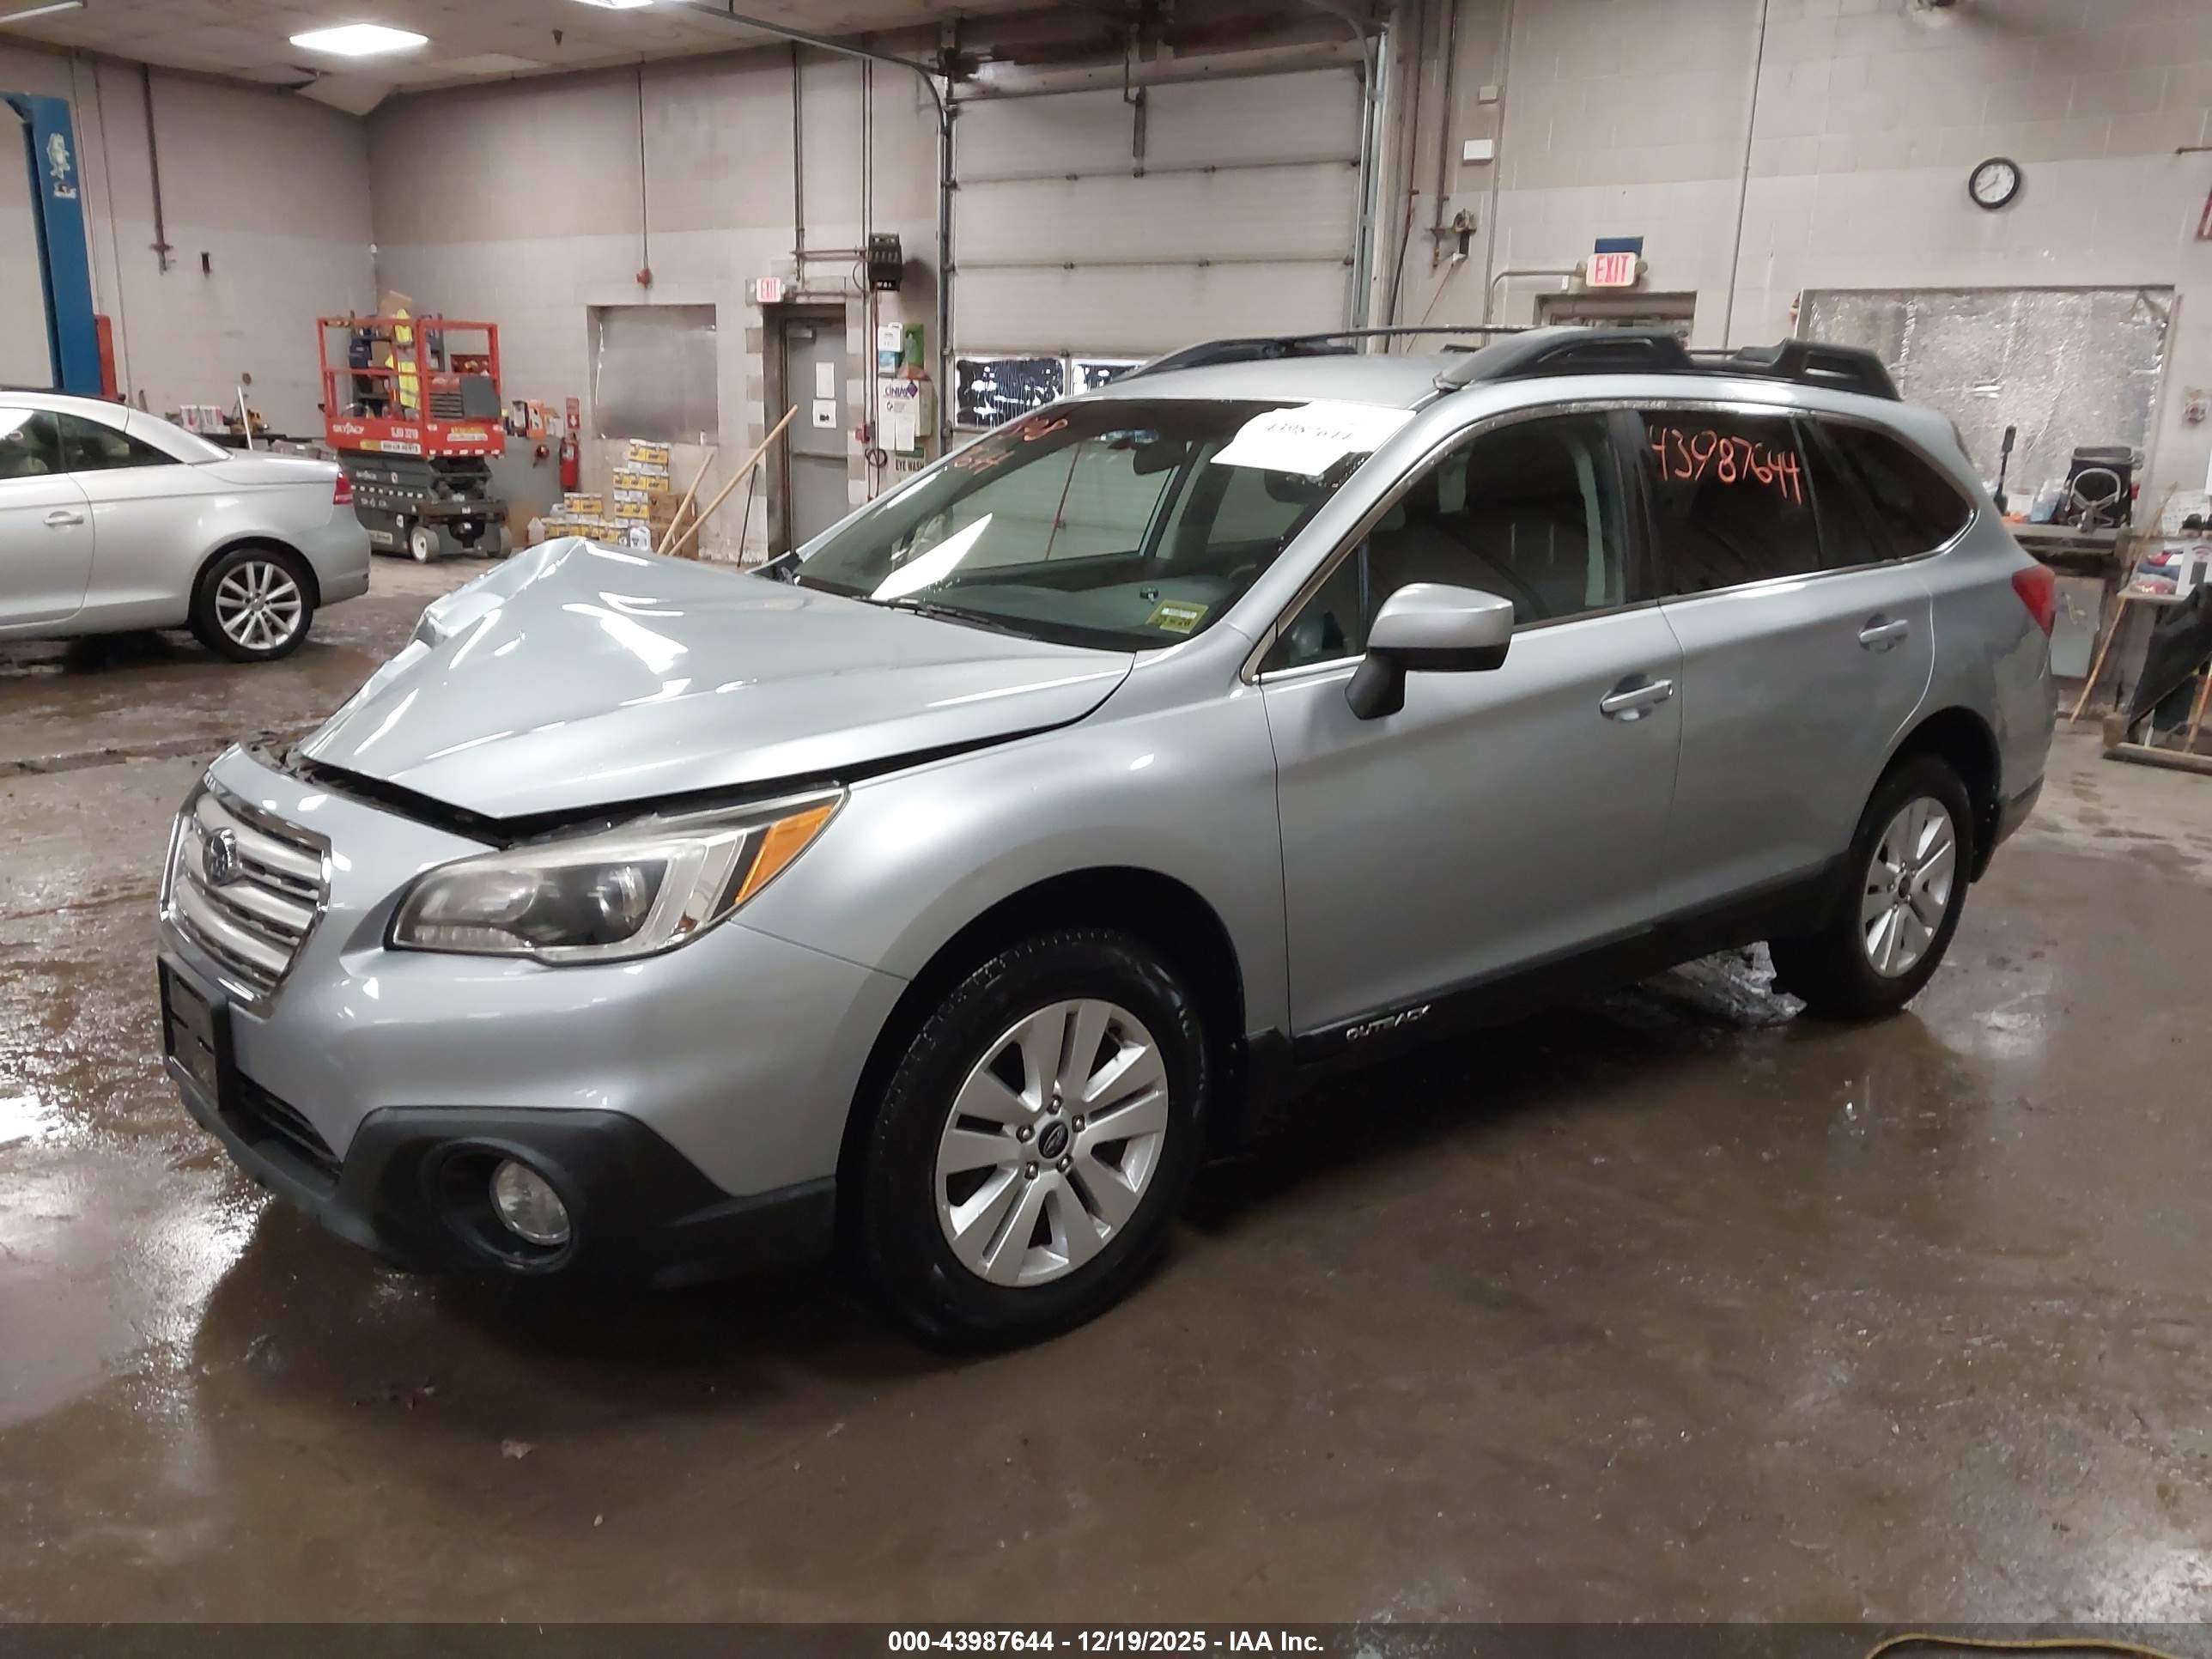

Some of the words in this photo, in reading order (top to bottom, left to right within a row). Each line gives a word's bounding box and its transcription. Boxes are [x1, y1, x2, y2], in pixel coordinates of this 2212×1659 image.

[1595, 255, 1629, 283] EXIT
[895, 459, 907, 471] EYE
[1650, 425, 1802, 507] 43987644
